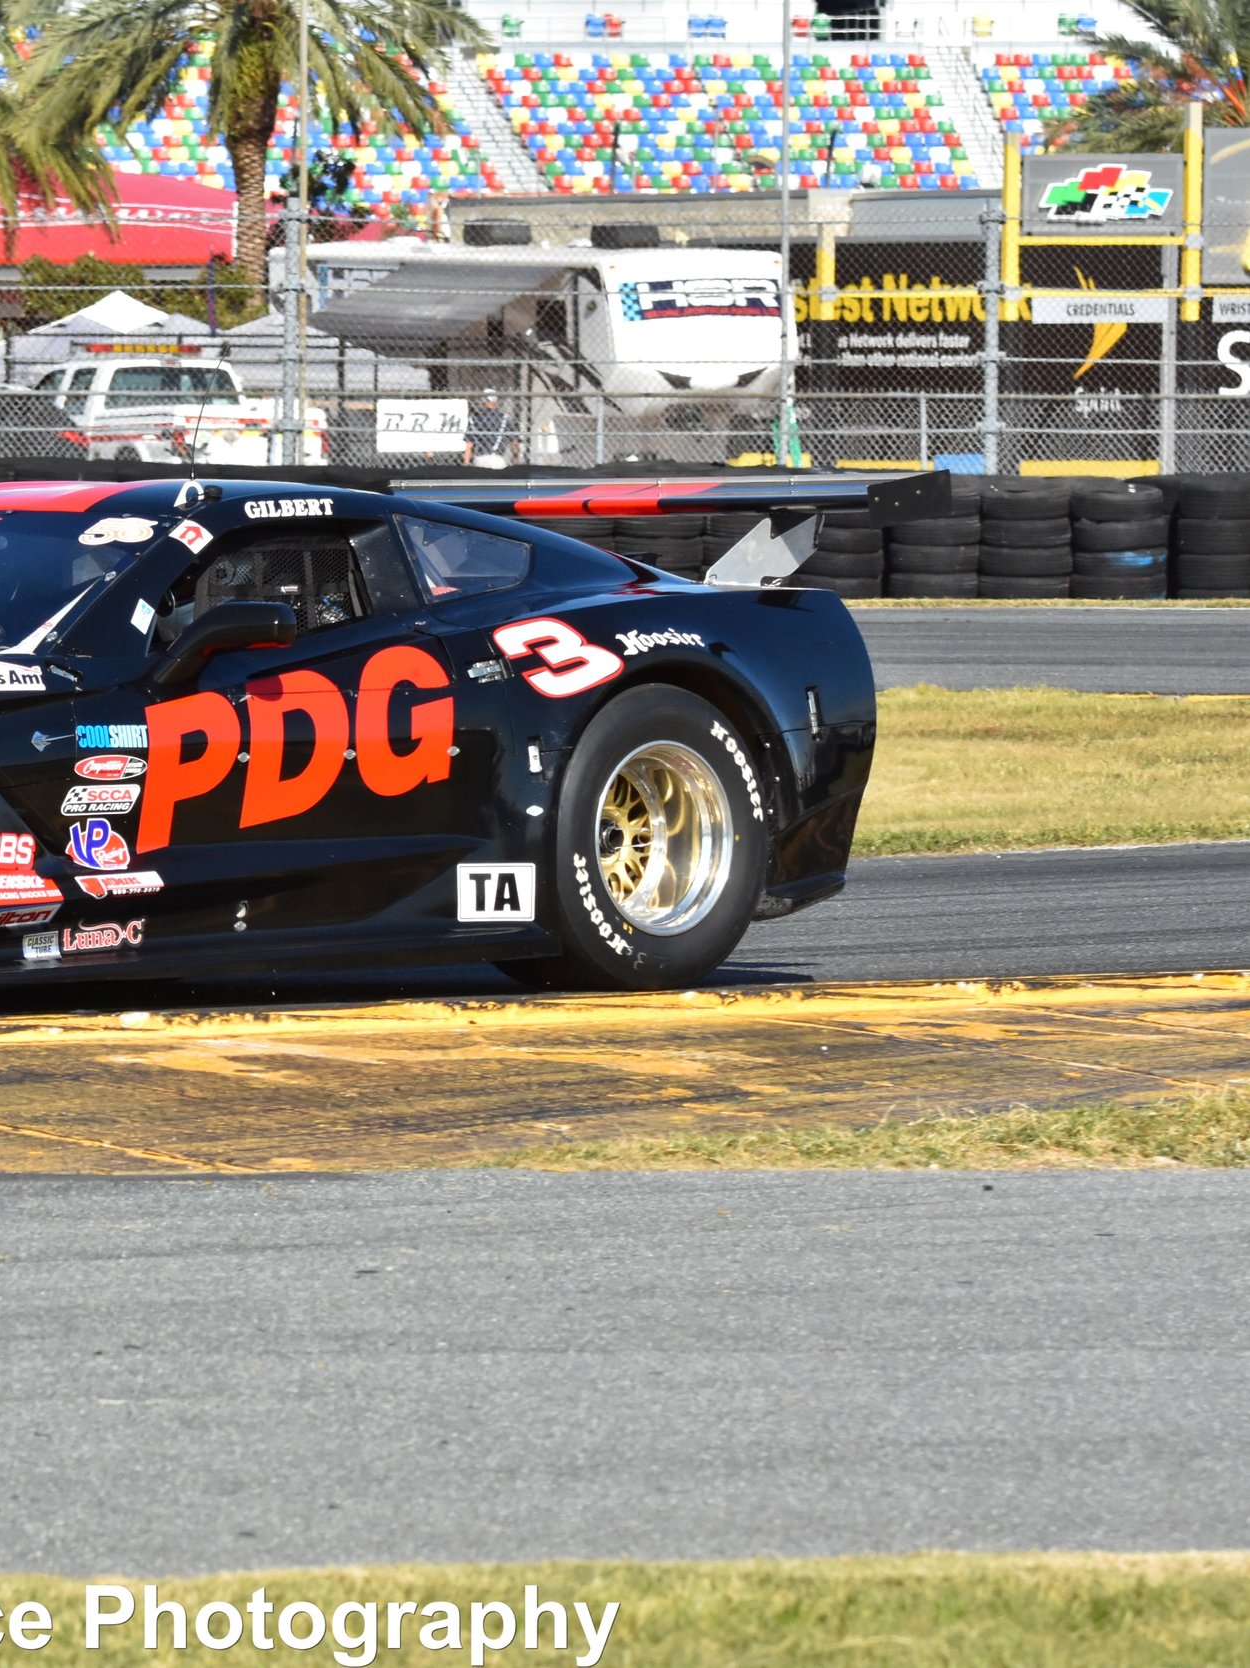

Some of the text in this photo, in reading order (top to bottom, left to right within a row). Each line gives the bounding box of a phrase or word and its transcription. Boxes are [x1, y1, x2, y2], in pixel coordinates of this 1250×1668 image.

[1066, 304, 1135, 316] CREDENTIALS
[244, 499, 334, 519] GILBERT
[615, 627, 705, 656] Hoosier
[493, 616, 625, 698] 3
[9, 670, 41, 685] Am
[136, 645, 455, 855] PDG
[709, 720, 764, 822] Hoosier
[64, 802, 131, 813] PRO RACING
[87, 790, 133, 802] SCCA
[70, 819, 111, 868] VP
[469, 873, 520, 912] TA
[573, 852, 632, 956] Hoosier
[27, 935, 54, 950] CLASSIC
